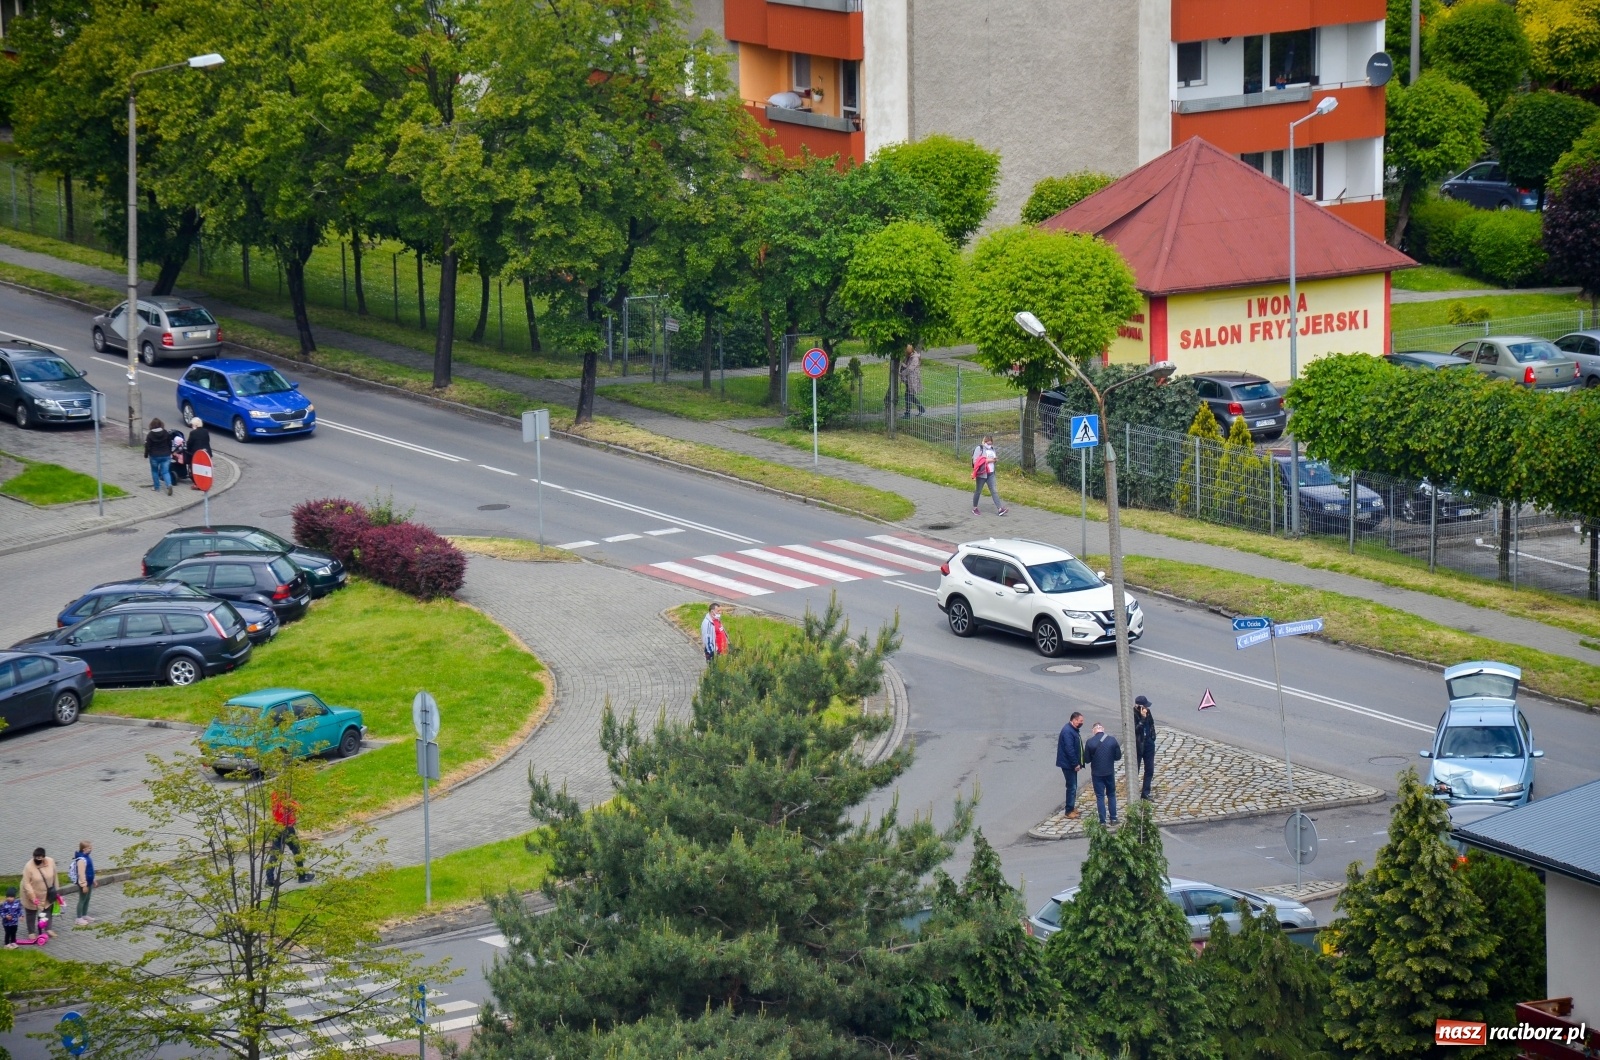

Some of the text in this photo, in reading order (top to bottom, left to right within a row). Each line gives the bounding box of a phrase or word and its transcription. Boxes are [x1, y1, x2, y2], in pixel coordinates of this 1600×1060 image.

[1180, 309, 1369, 350] SALON FRYZJERSKI
[1285, 623, 1314, 634] Słowackiego
